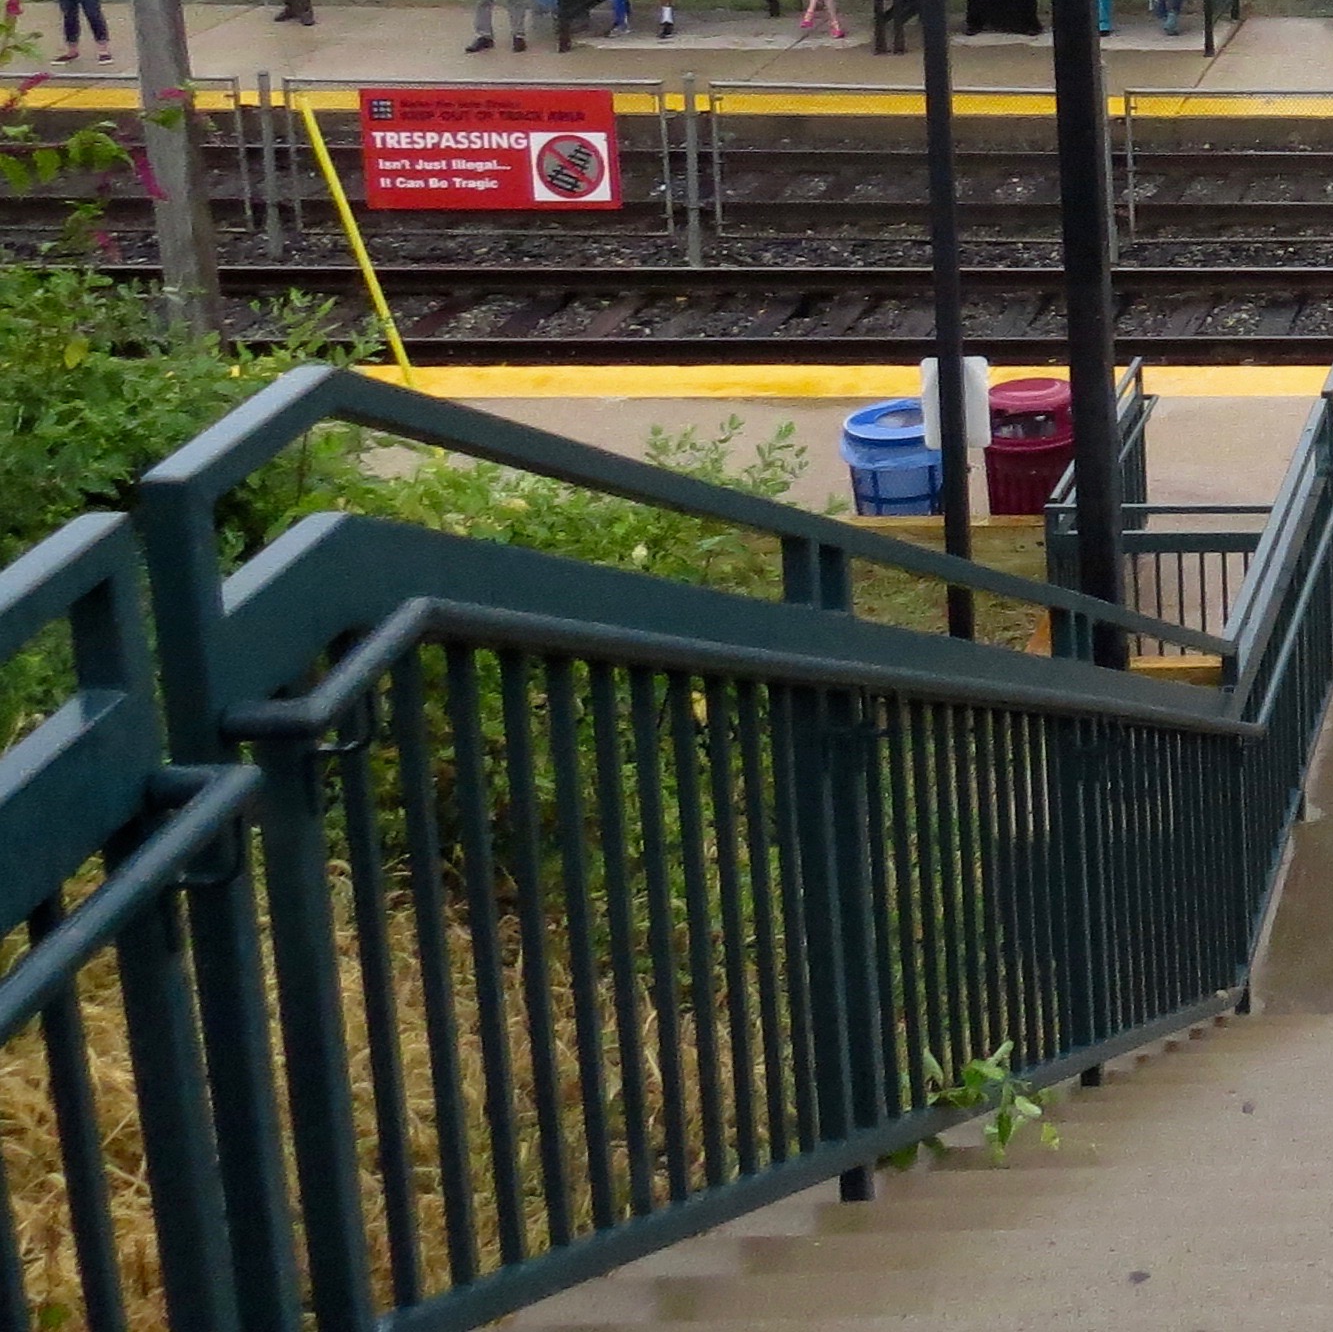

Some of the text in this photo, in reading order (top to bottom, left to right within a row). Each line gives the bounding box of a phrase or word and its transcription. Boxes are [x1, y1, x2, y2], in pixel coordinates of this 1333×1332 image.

[372, 132, 528, 150] TRESPASSING
[378, 158, 411, 170] Isn't
[415, 159, 447, 170] Just
[380, 177, 499, 190] It Can Be Tragic
